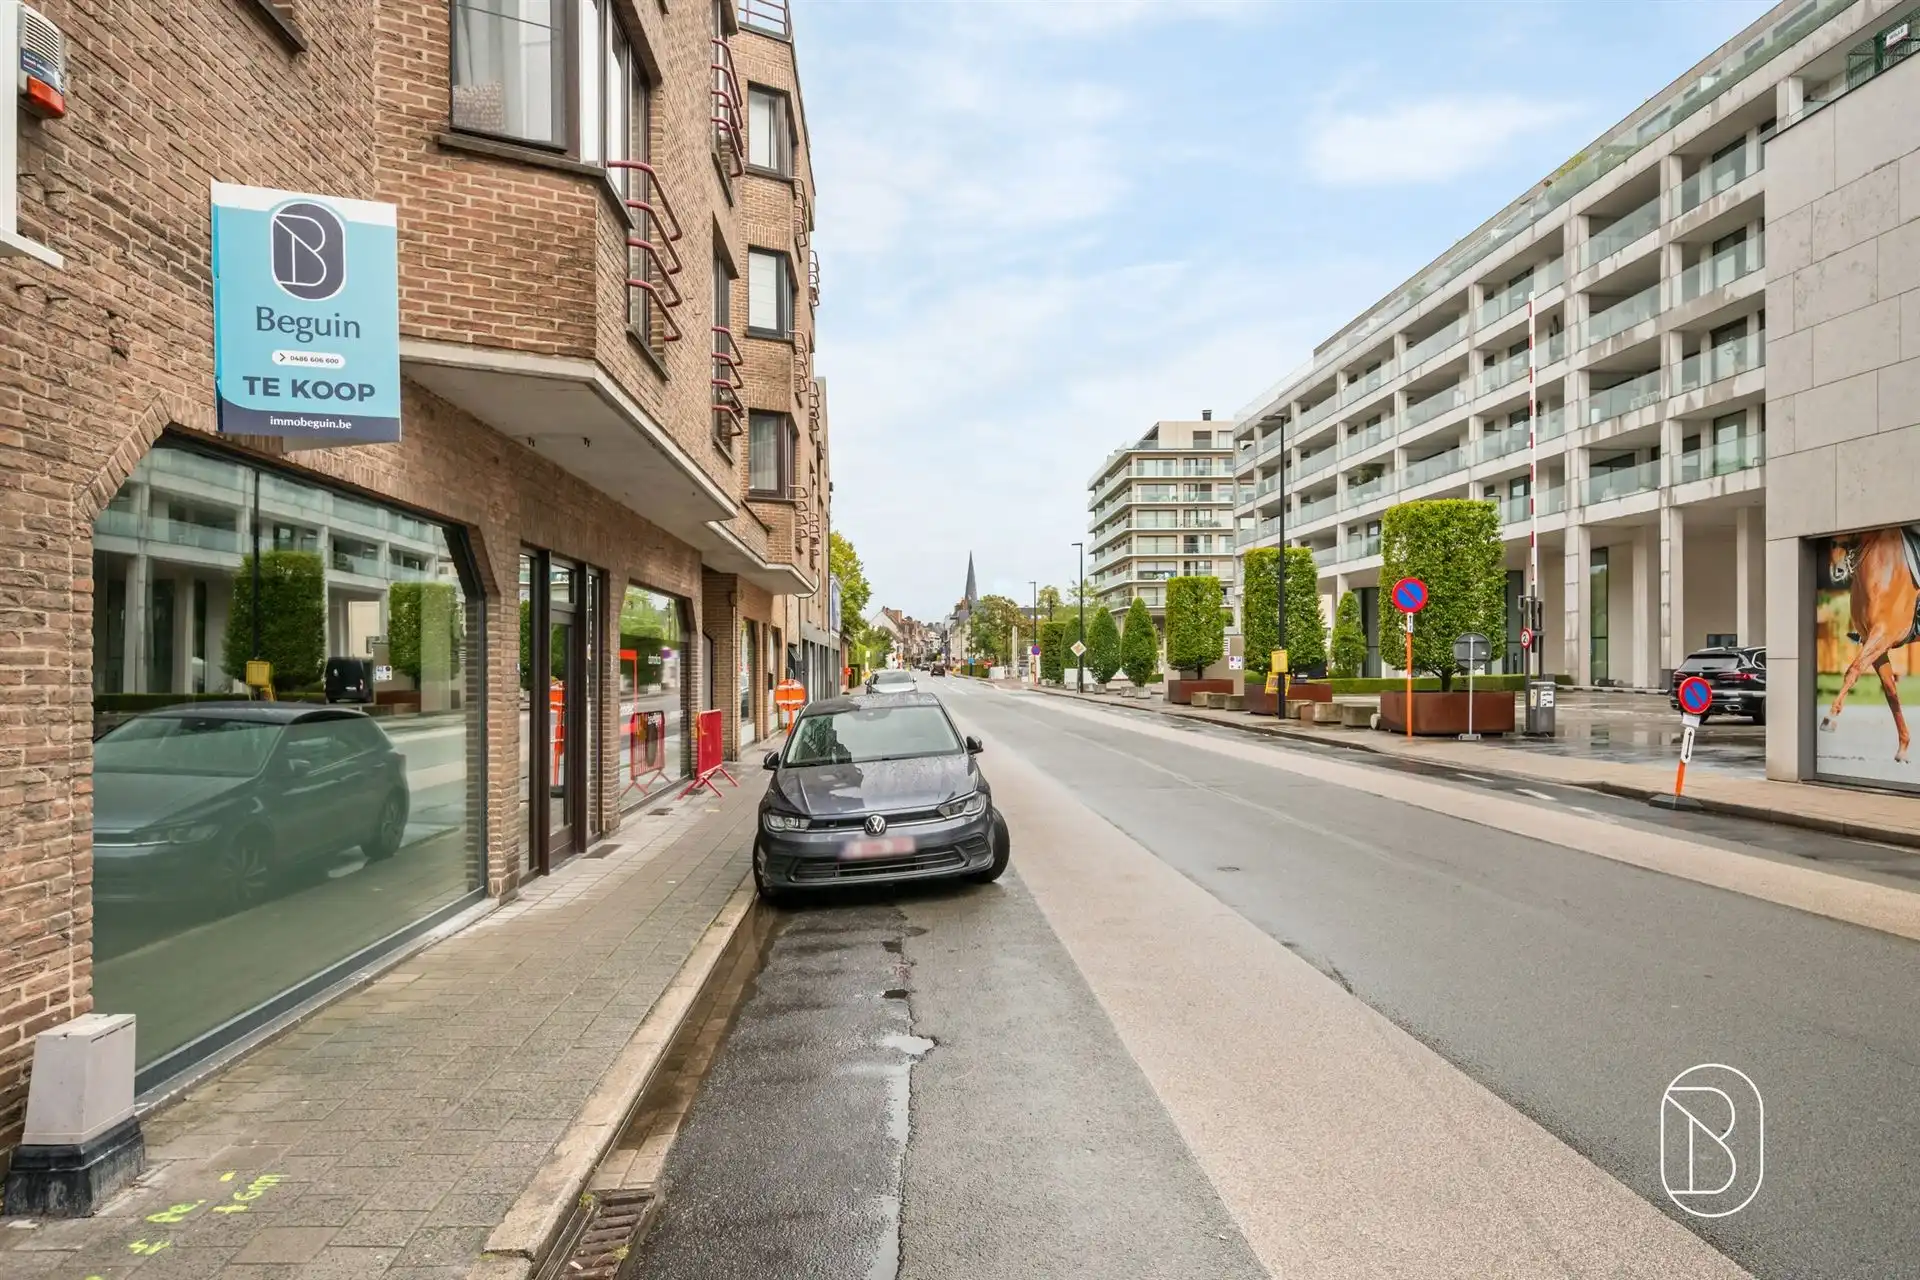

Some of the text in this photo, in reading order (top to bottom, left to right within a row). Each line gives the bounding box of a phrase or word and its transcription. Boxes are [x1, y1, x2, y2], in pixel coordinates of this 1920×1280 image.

[257, 306, 360, 342] Beguin
[243, 376, 376, 401] TE KOOP
[270, 416, 352, 429] immobeguin.be
